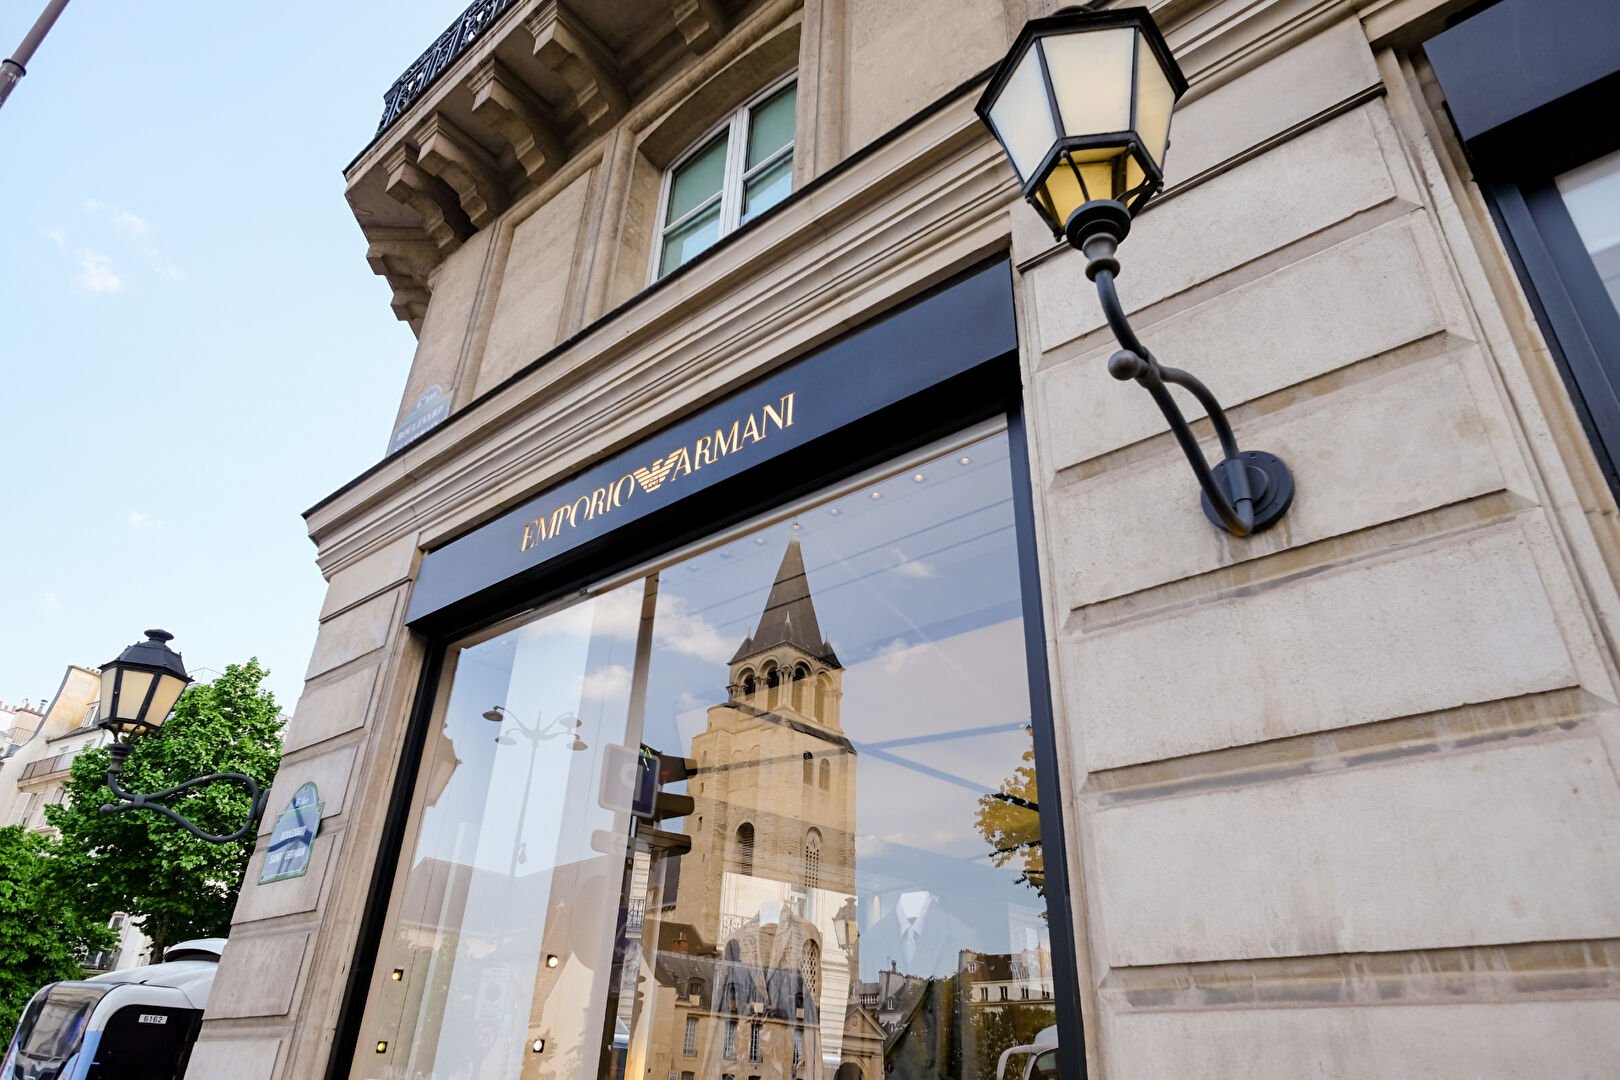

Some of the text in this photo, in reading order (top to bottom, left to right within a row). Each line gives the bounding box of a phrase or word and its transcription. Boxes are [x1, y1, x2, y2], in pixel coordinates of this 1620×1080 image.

[520, 392, 795, 552] EMPORIO ARMANI
[143, 1015, 163, 1023] 6162
